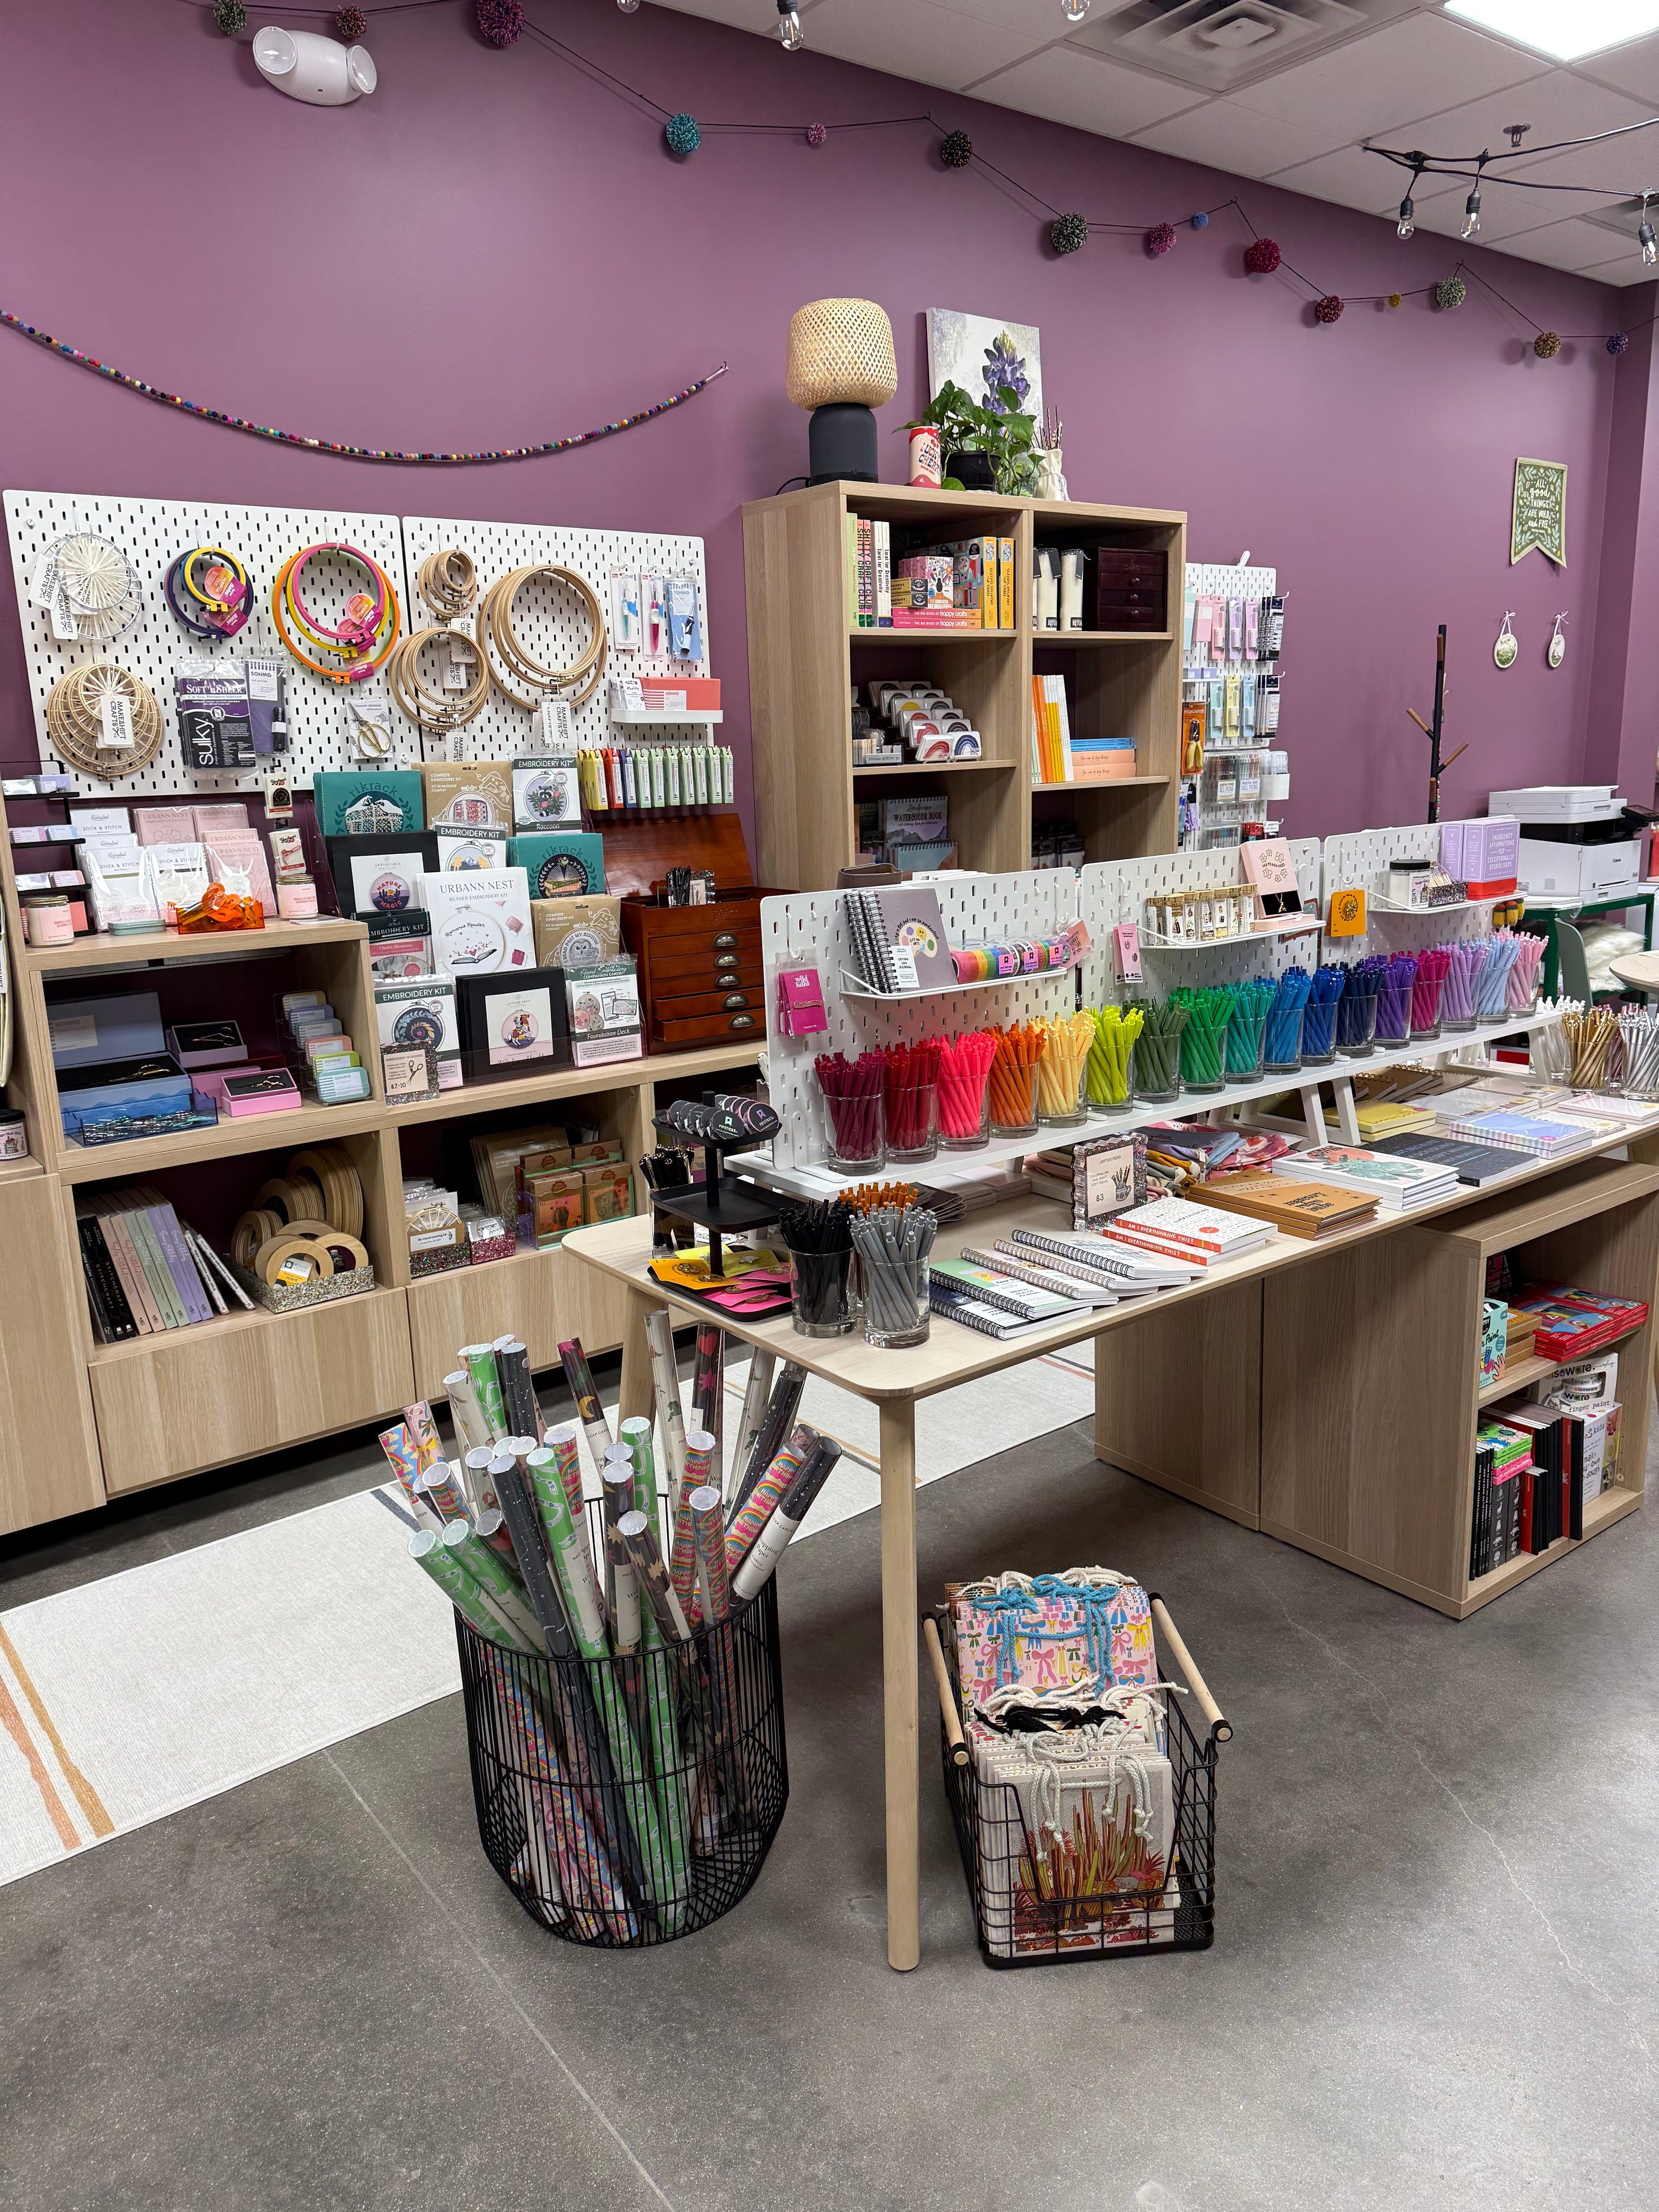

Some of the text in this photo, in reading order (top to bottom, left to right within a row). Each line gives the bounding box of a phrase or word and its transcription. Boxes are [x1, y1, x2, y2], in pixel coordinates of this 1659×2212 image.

[1536, 479, 1545, 488] ALL
[1530, 485, 1550, 498] good
[1530, 498, 1549, 508] THINGS
[1528, 509, 1549, 518] ARE WILD
[1538, 520, 1548, 529] FREE
[940, 610, 954, 619] happy
[940, 620, 954, 629] happy
[117, 701, 126, 740] MAKESHIFT
[192, 718, 214, 765] Sulky
[350, 782, 398, 798] rikrack
[893, 812, 942, 822] WATERCOLOR BOOK
[441, 828, 487, 838] EMBROIDERY
[1490, 840, 1515, 849] AFFIRMATIONS
[542, 846, 584, 860] rikrack
[1487, 854, 1515, 863] EXCEPTIONALLY
[376, 881, 402, 891] NATURE
[440, 880, 514, 894] URBANN NEST
[380, 900, 402, 909] MAGIC
[445, 924, 466, 937] Romance
[566, 936, 574, 948] PAST
[583, 932, 600, 945] BEDTIME
[383, 989, 433, 1001] EMBROIDERY
[55, 1019, 80, 1028] SOHMO
[587, 1031, 616, 1040] Foundation
[759, 1116, 774, 1126] PIPSTICKS
[719, 1123, 737, 1132] PIPSTICKS
[1283, 1192, 1328, 1206] mercury
[1295, 1199, 1323, 1209] retro
[1140, 1226, 1177, 1238] OVERTHINKING
[1177, 1234, 1194, 1243] THIS?
[177, 1243, 191, 1263] Stitches
[1127, 1237, 1163, 1251] OVERTHINKING
[1164, 1246, 1180, 1257] THIS?
[165, 1244, 178, 1263] Stitches
[95, 1263, 114, 1309] STITCHCRAFT
[105, 1261, 124, 1307] STITCHCRAFT
[1488, 1329, 1500, 1341] Paint
[1569, 1401, 1610, 1413] finger paint
[1593, 1423, 1605, 1435] kids
[779, 1524, 794, 1534] CARDS
[755, 1544, 769, 1559] Paper
